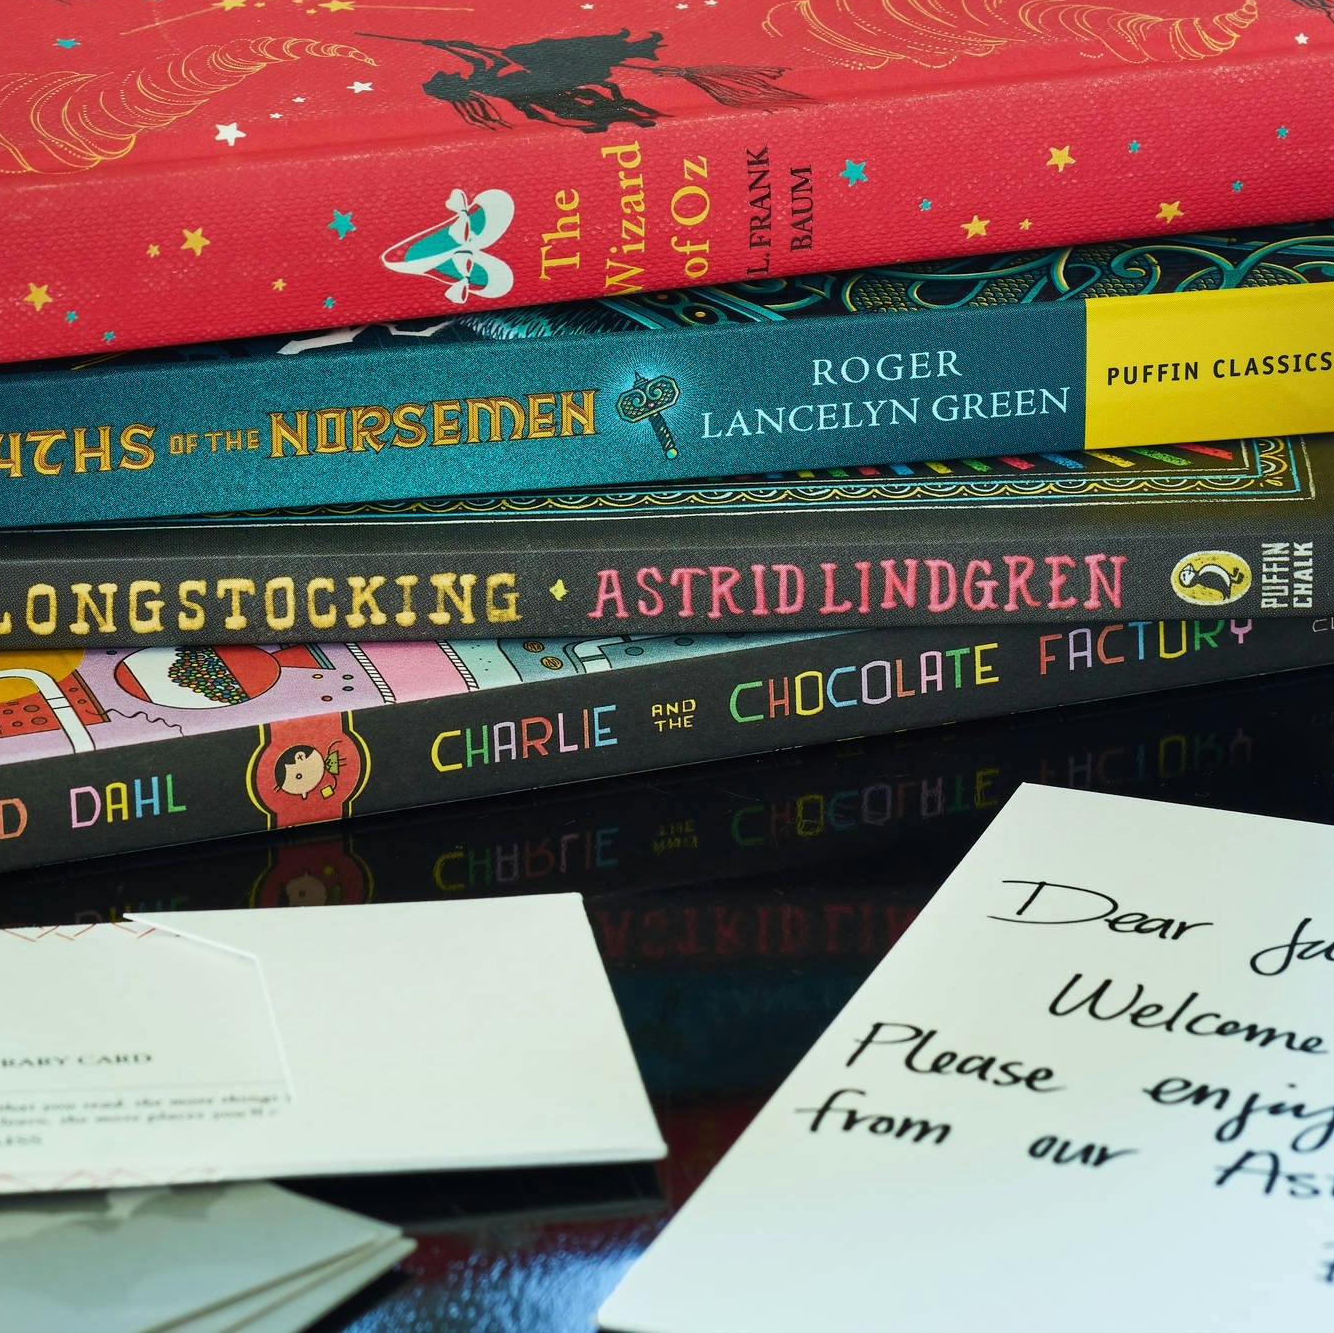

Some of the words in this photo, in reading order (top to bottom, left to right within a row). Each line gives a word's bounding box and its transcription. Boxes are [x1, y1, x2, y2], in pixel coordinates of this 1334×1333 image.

[601, 140, 646, 296] Wizard
[671, 154, 710, 226] Oz
[746, 145, 771, 250] FRANK
[790, 165, 813, 251] BAUM
[539, 188, 580, 280] The
[671, 236, 710, 279] of
[812, 349, 962, 386] ROGER
[1107, 361, 1199, 386] PUFFIN
[1212, 351, 1334, 379] CLASSICS
[169, 433, 204, 456] OF
[205, 428, 261, 453] THE
[267, 388, 601, 459] NORSEMEN
[701, 398, 920, 440] LANCELYN
[931, 386, 1071, 422] GREEN
[587, 563, 805, 621] ASTRID
[818, 552, 1130, 616] LINDGREN
[1260, 542, 1291, 609] PUFFIN
[1293, 541, 1314, 609] CHALK
[728, 641, 1000, 724] CHOCOLATE
[1038, 619, 1254, 676] FACTORY
[430, 704, 619, 773] CHARLIE
[650, 696, 697, 717] AND
[654, 713, 695, 733] THE
[70, 773, 187, 830] DAHL
[987, 878, 1214, 942] Dear
[1048, 972, 1328, 1056] Welcome
[845, 1021, 1068, 1094] Please
[795, 1088, 953, 1146] from
[1027, 1134, 1141, 1169] our
